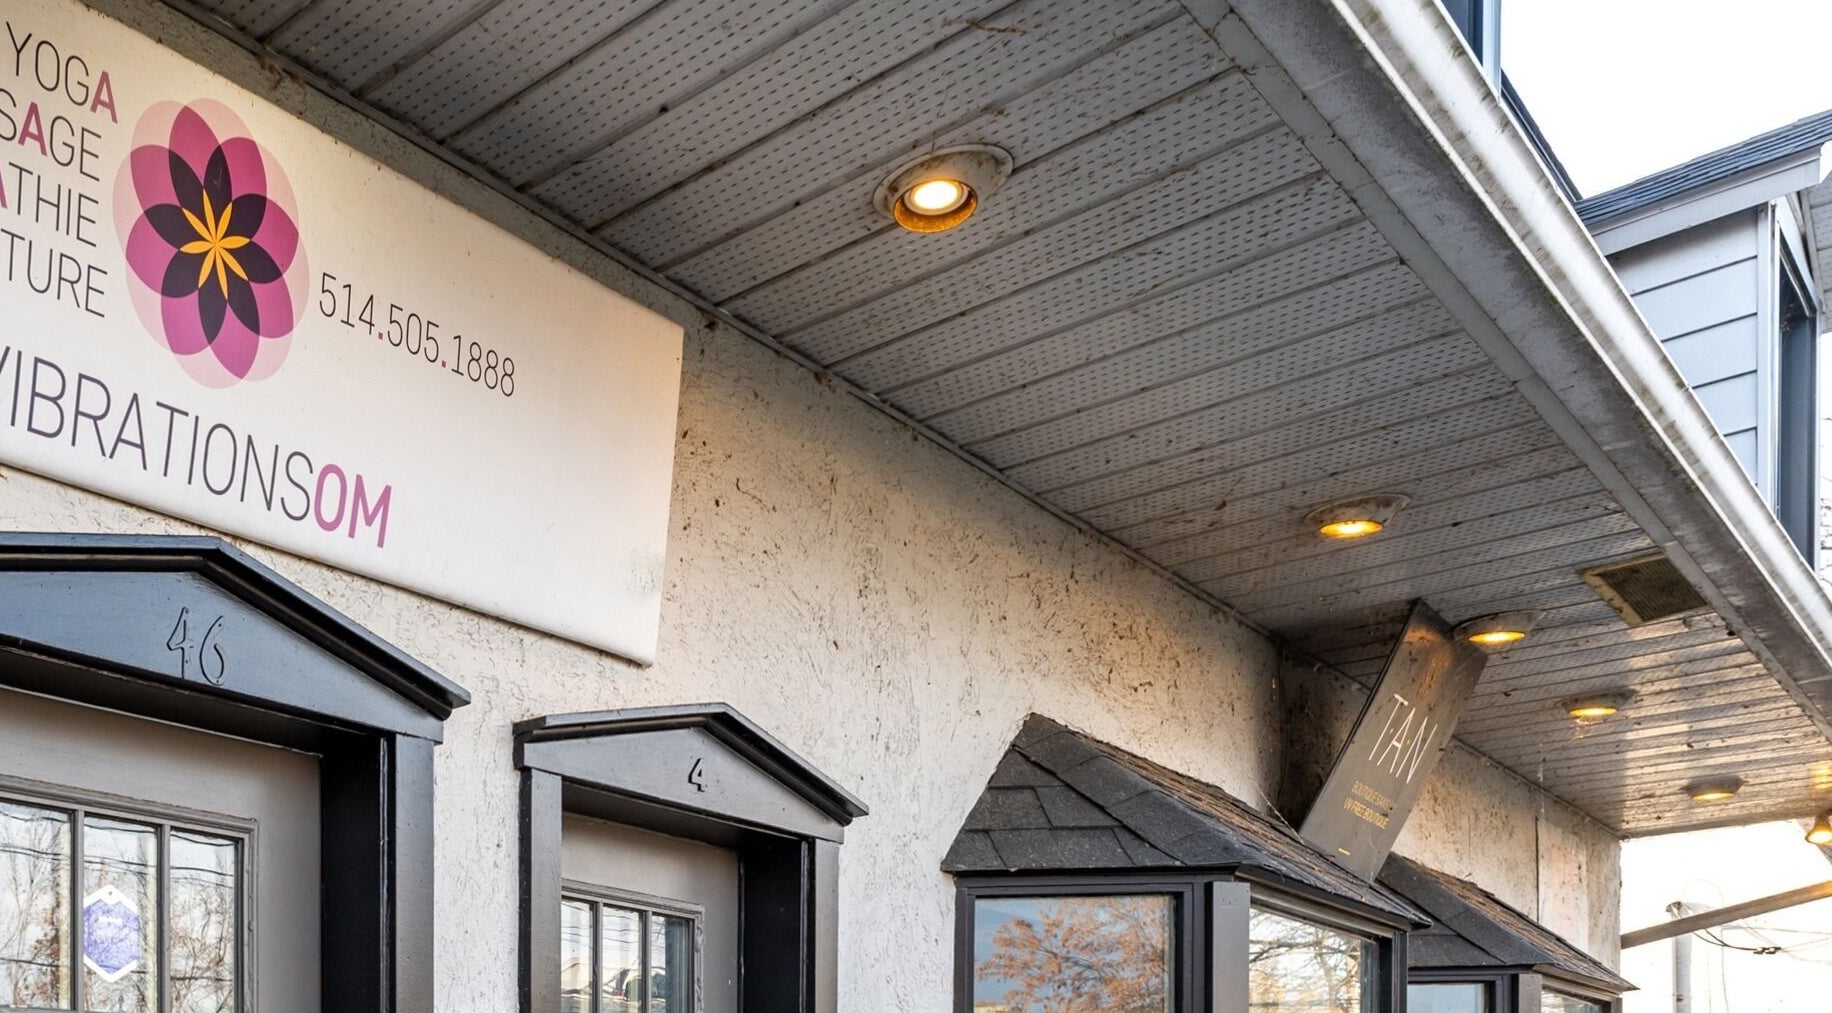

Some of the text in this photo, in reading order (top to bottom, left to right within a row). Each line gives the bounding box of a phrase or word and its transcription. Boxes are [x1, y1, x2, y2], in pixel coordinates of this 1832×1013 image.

[6, 21, 118, 124] YOGA
[319, 272, 516, 397] 514.505.1888
[167, 607, 227, 686] 46
[688, 757, 706, 793] 4
[1368, 693, 1438, 785] TAN
